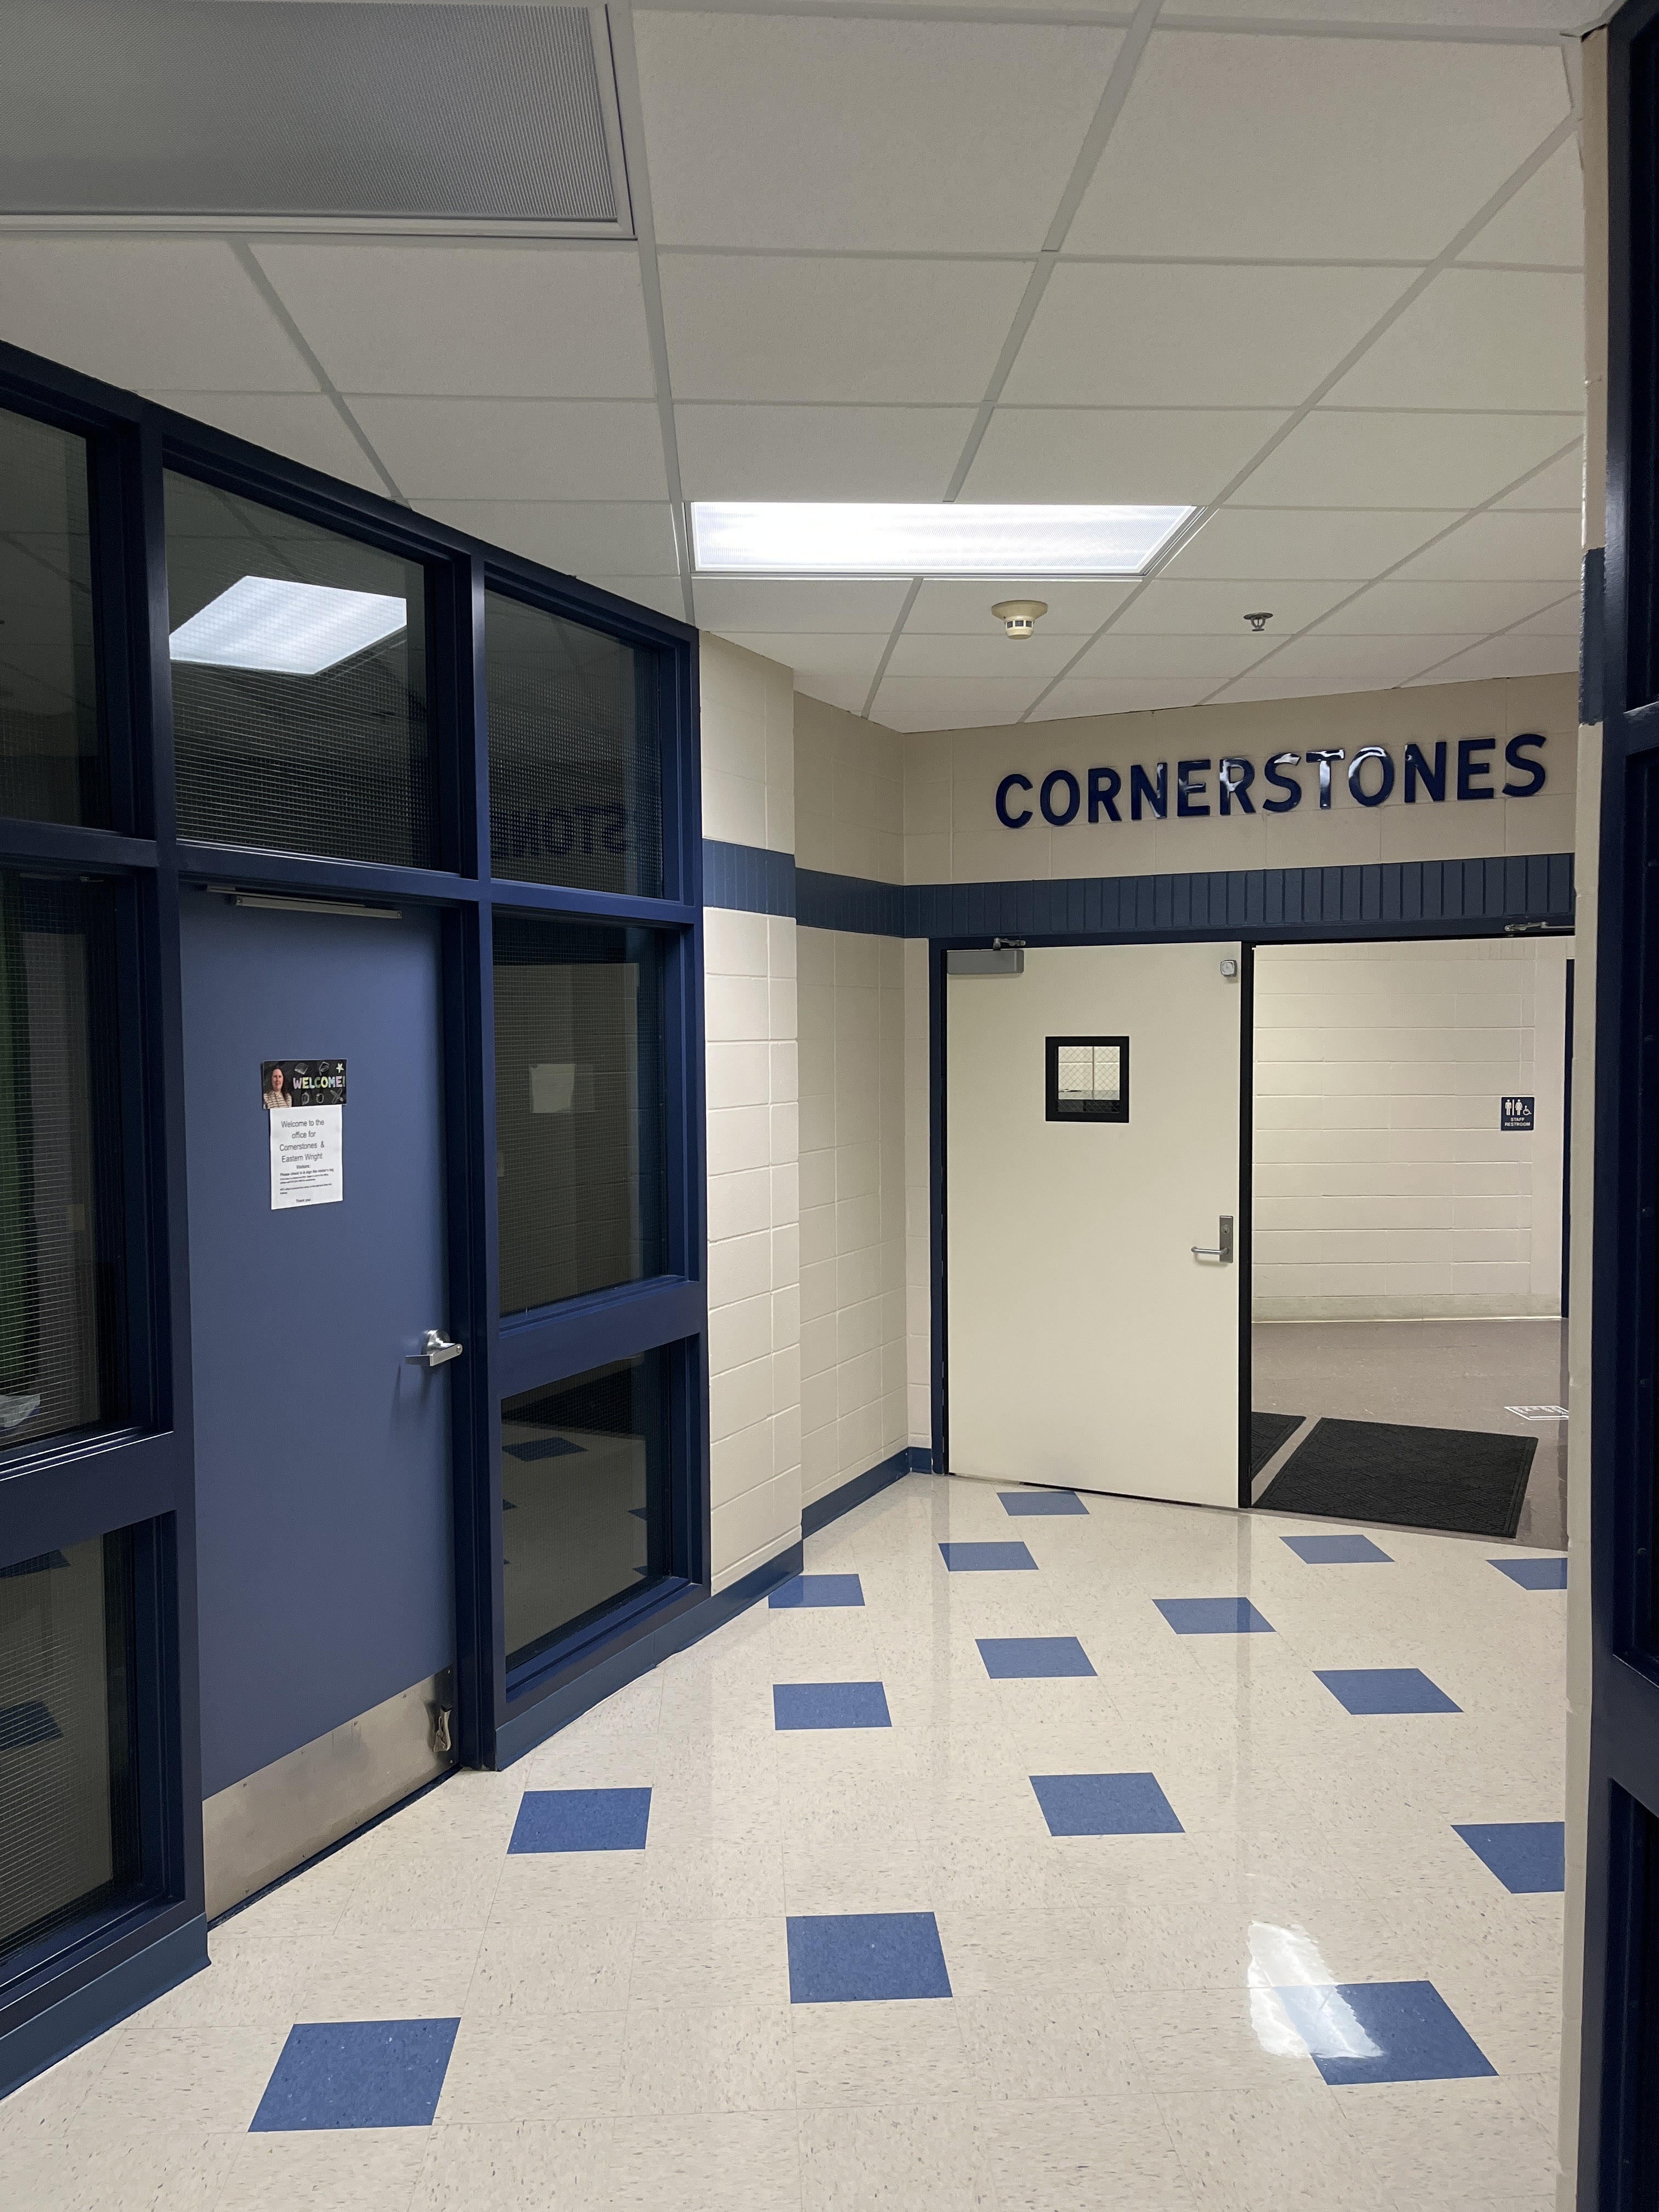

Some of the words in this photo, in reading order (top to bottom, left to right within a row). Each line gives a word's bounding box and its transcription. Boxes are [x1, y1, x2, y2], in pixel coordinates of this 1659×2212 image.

[995, 733, 1547, 829] CORNERSTONES
[293, 1076, 346, 1089] WELCOME!
[279, 1143, 318, 1151] Cornerstones
[304, 1153, 323, 1161] Wright
